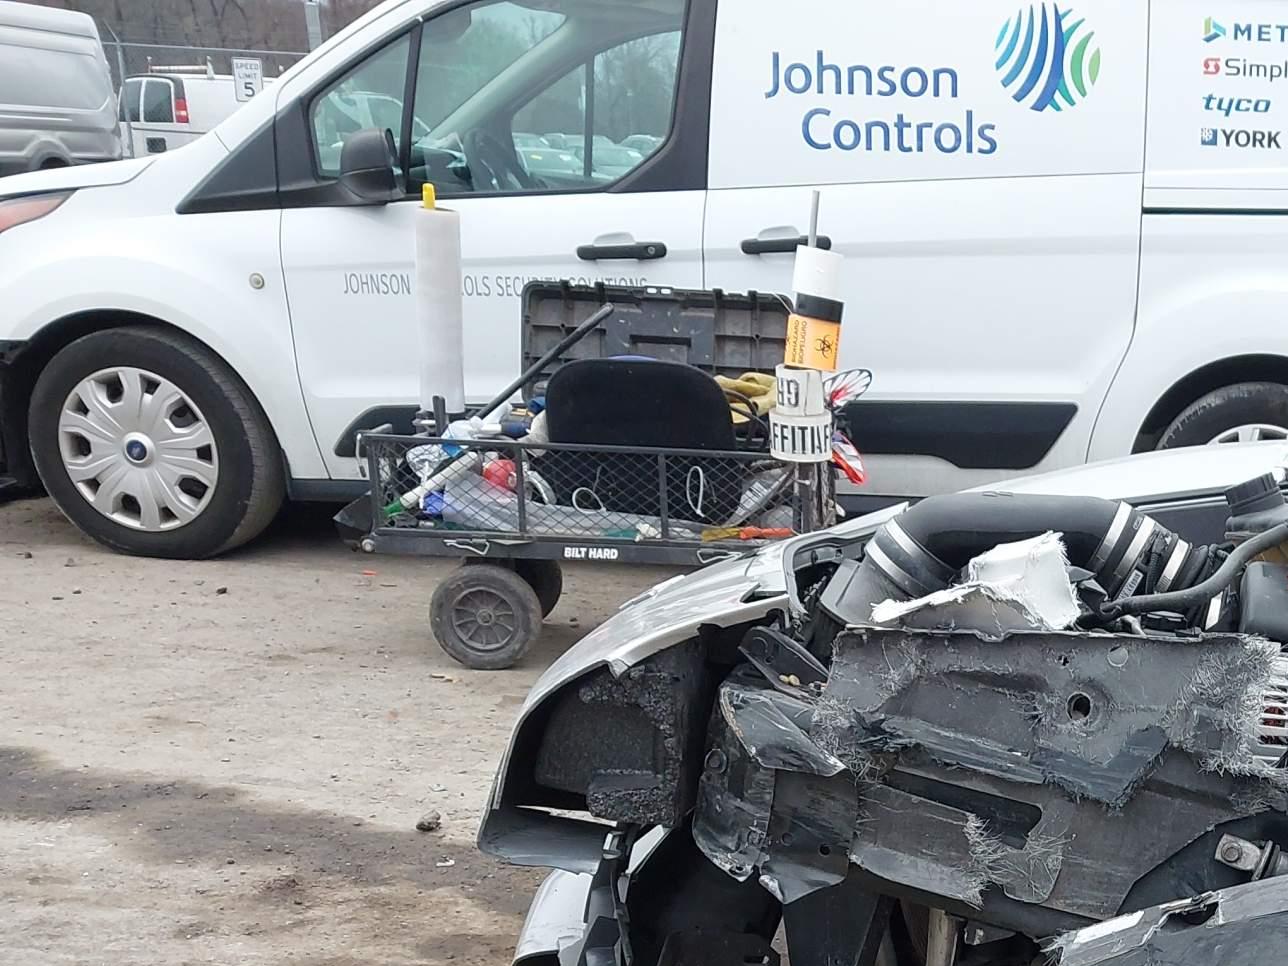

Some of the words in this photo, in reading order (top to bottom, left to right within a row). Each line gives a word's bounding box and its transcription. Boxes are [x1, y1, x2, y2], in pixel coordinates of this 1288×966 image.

[765, 50, 958, 99] Johnson
[244, 81, 255, 97] 5
[1202, 93, 1272, 118] tyco
[801, 107, 998, 155] Controls
[1220, 128, 1282, 150] YORK
[343, 272, 412, 295] JOHNSON
[564, 546, 587, 558] BILT
[588, 547, 619, 560] HARD
